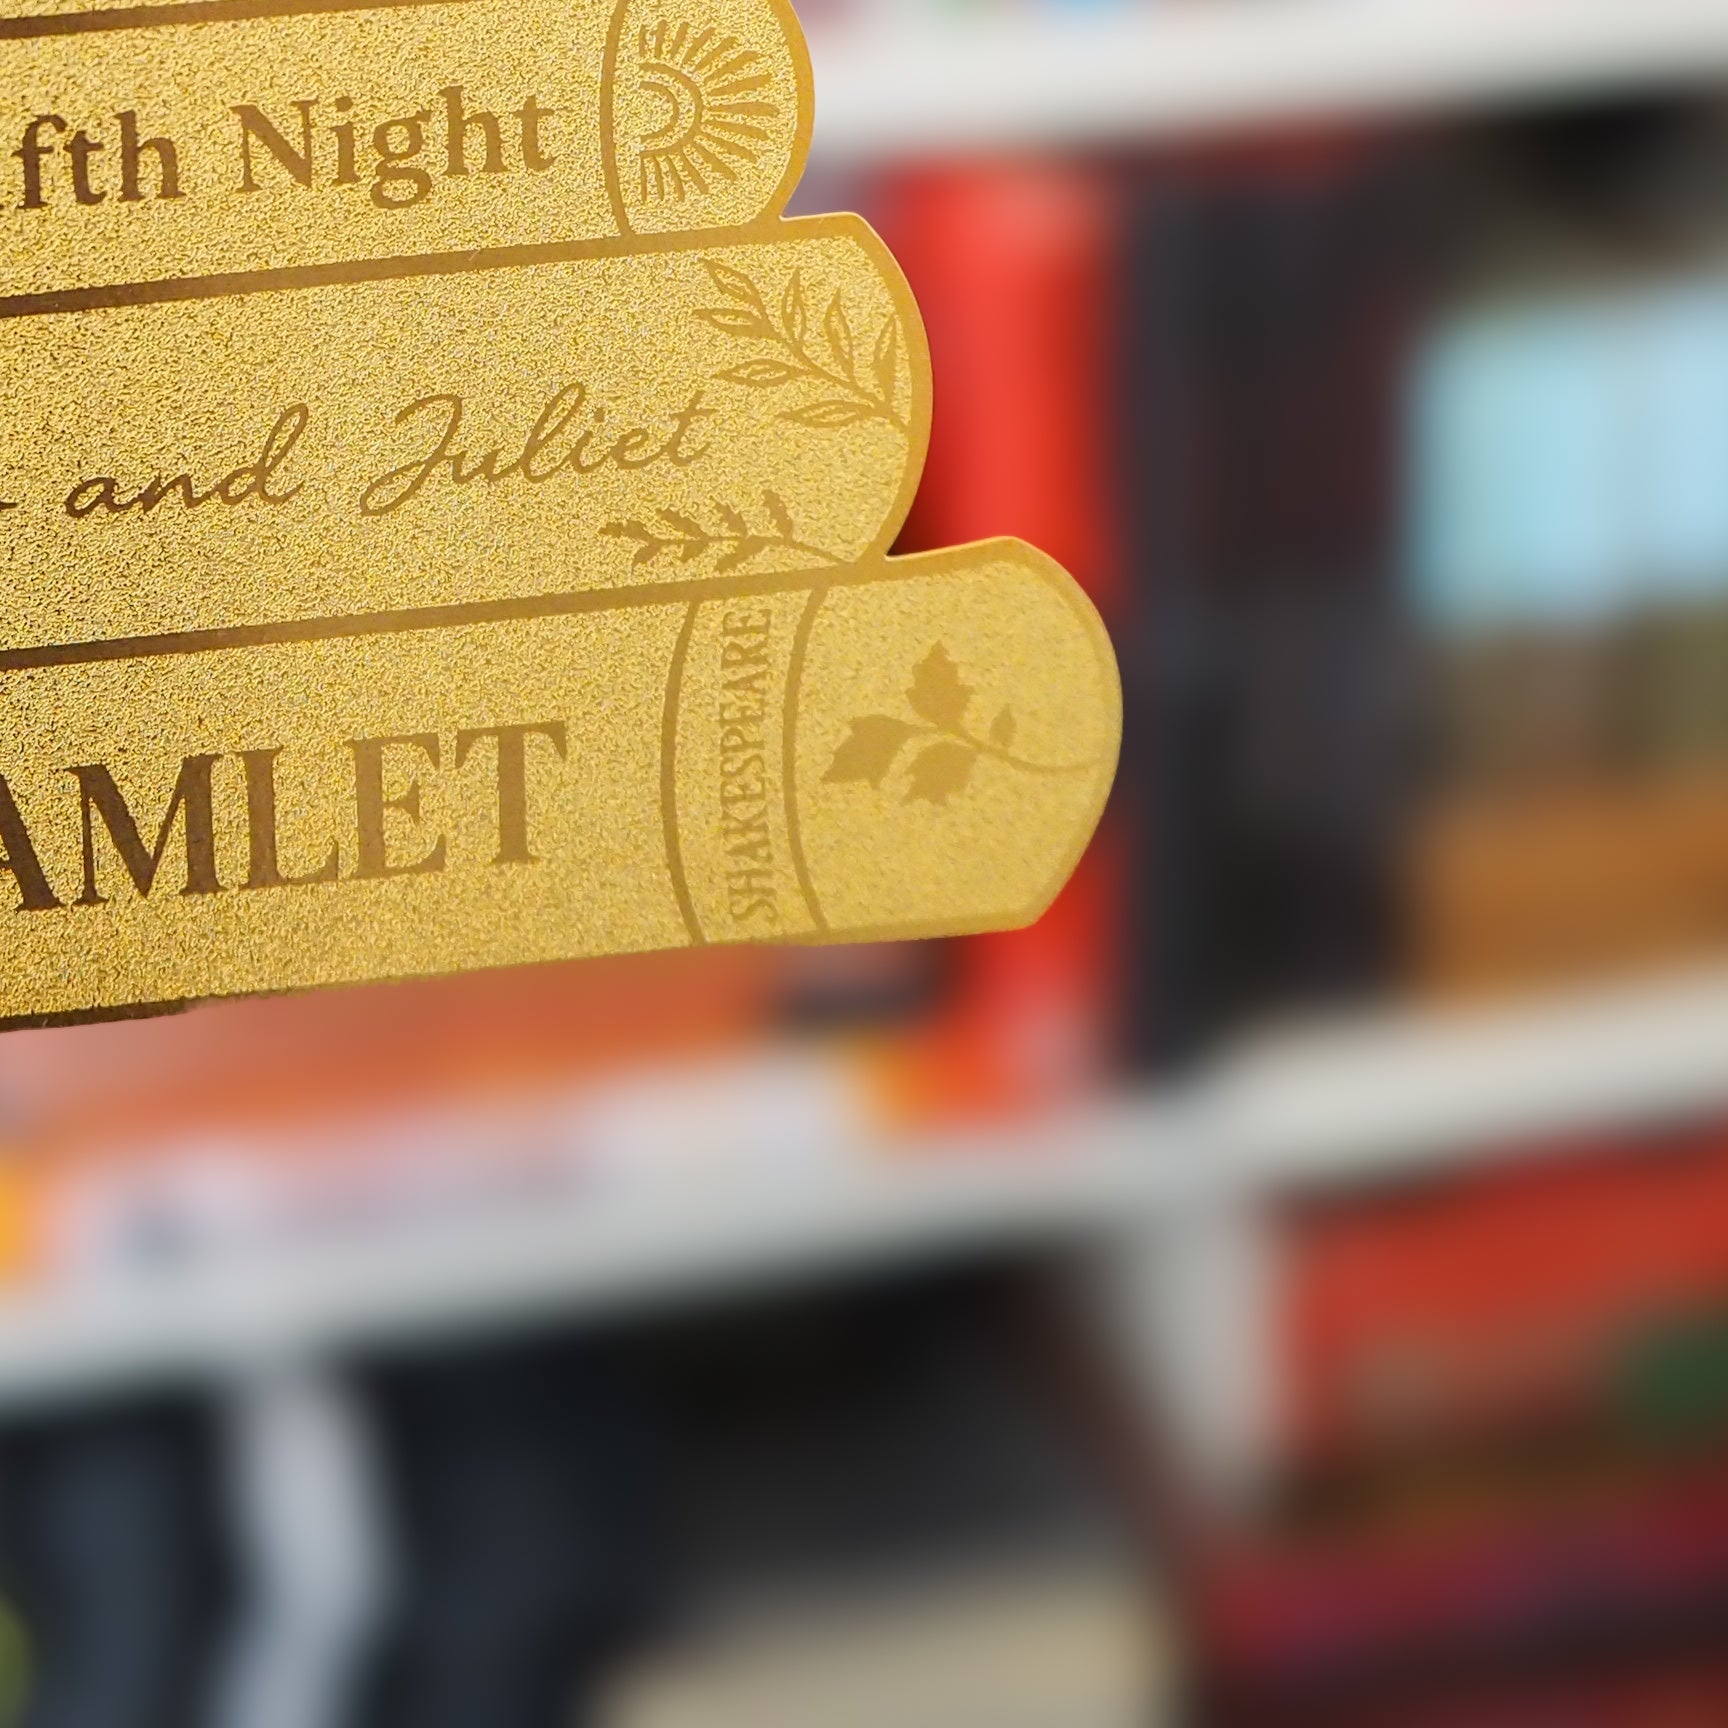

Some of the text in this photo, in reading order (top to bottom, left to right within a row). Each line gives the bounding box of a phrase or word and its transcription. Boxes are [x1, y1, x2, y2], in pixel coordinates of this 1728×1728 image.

[232, 87, 559, 210] Night
[67, 404, 308, 515] and
[361, 382, 715, 516] Juliet
[720, 605, 777, 927] SHAKESPEARE
